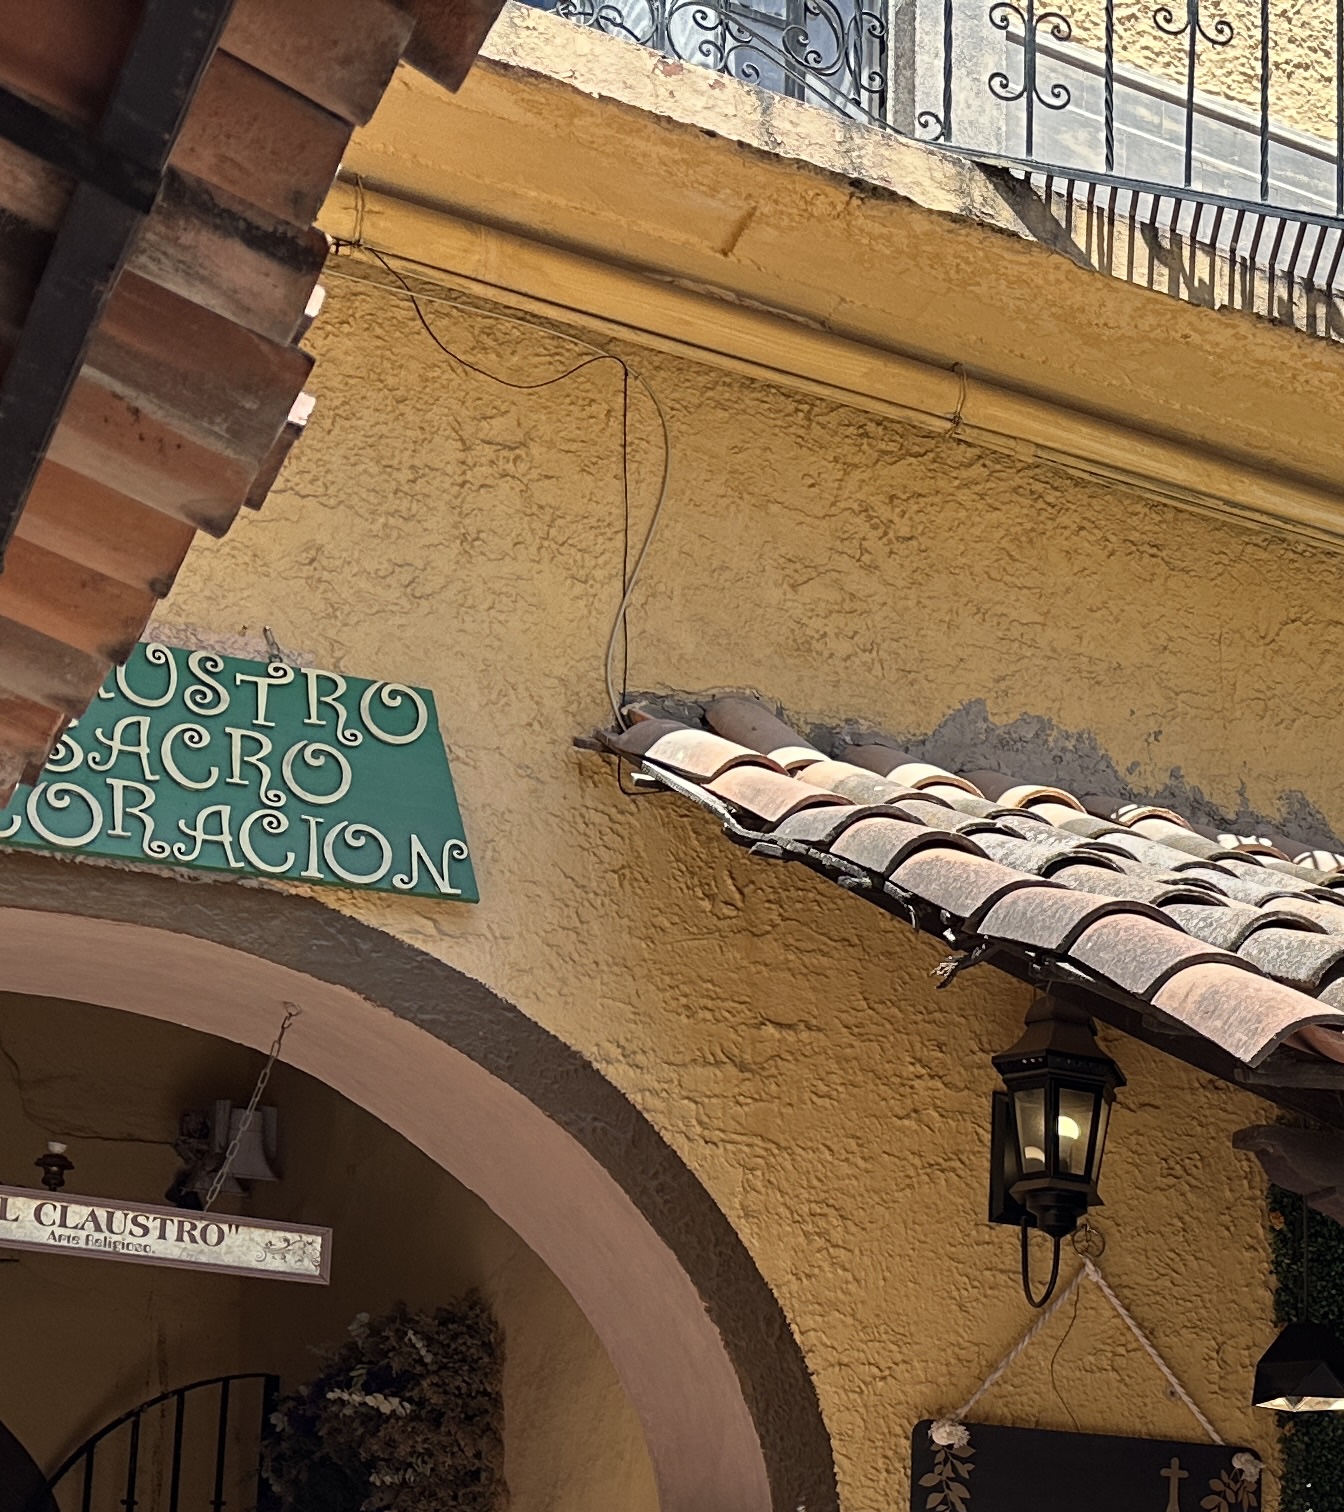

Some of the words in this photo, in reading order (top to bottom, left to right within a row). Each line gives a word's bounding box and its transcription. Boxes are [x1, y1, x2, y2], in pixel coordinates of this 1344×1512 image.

[98, 642, 428, 747] USTRO
[0, 777, 468, 895] ORACION
[47, 1230, 81, 1245] Arte
